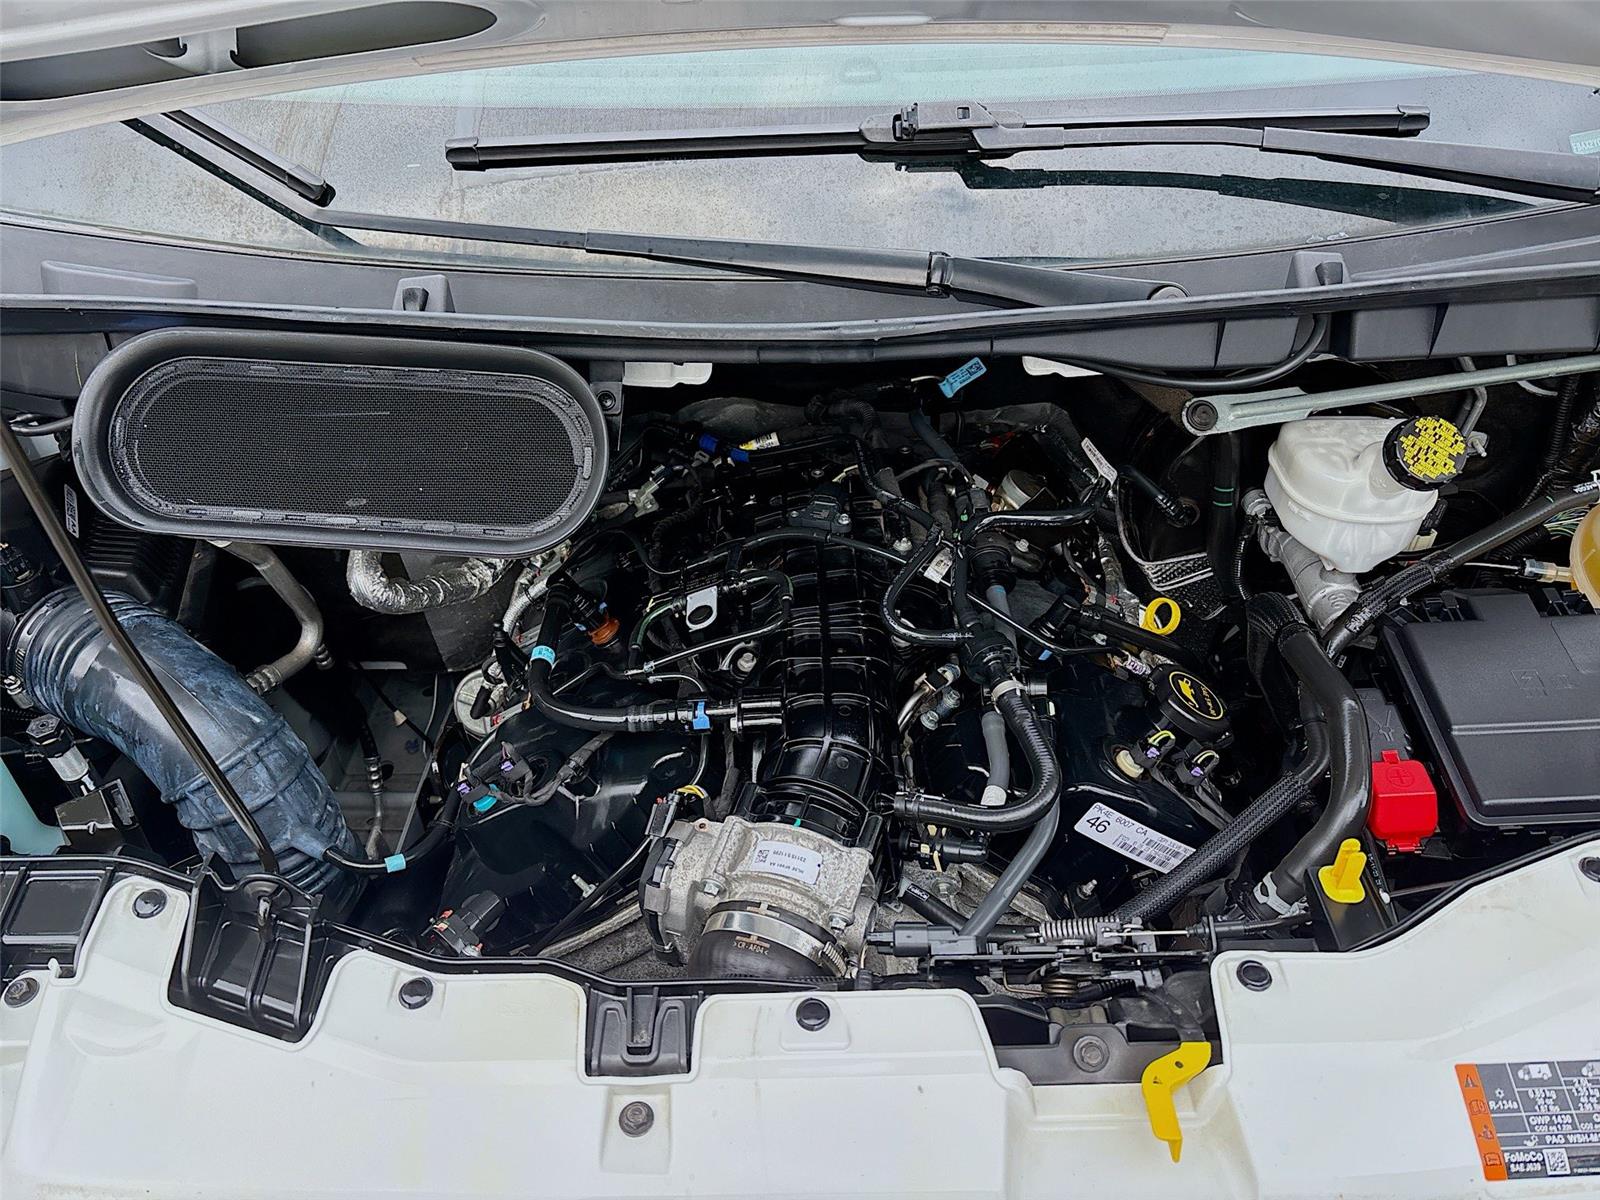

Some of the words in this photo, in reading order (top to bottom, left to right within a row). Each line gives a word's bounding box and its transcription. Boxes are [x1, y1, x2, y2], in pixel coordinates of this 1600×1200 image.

[1086, 816, 1111, 834] 46
[1093, 804, 1115, 819] PK4E
[1115, 816, 1135, 829] 6007
[1135, 826, 1149, 837] CA
[1567, 1133, 1600, 1144] WSH-M
[1504, 1152, 1544, 1162] FoMoCo
